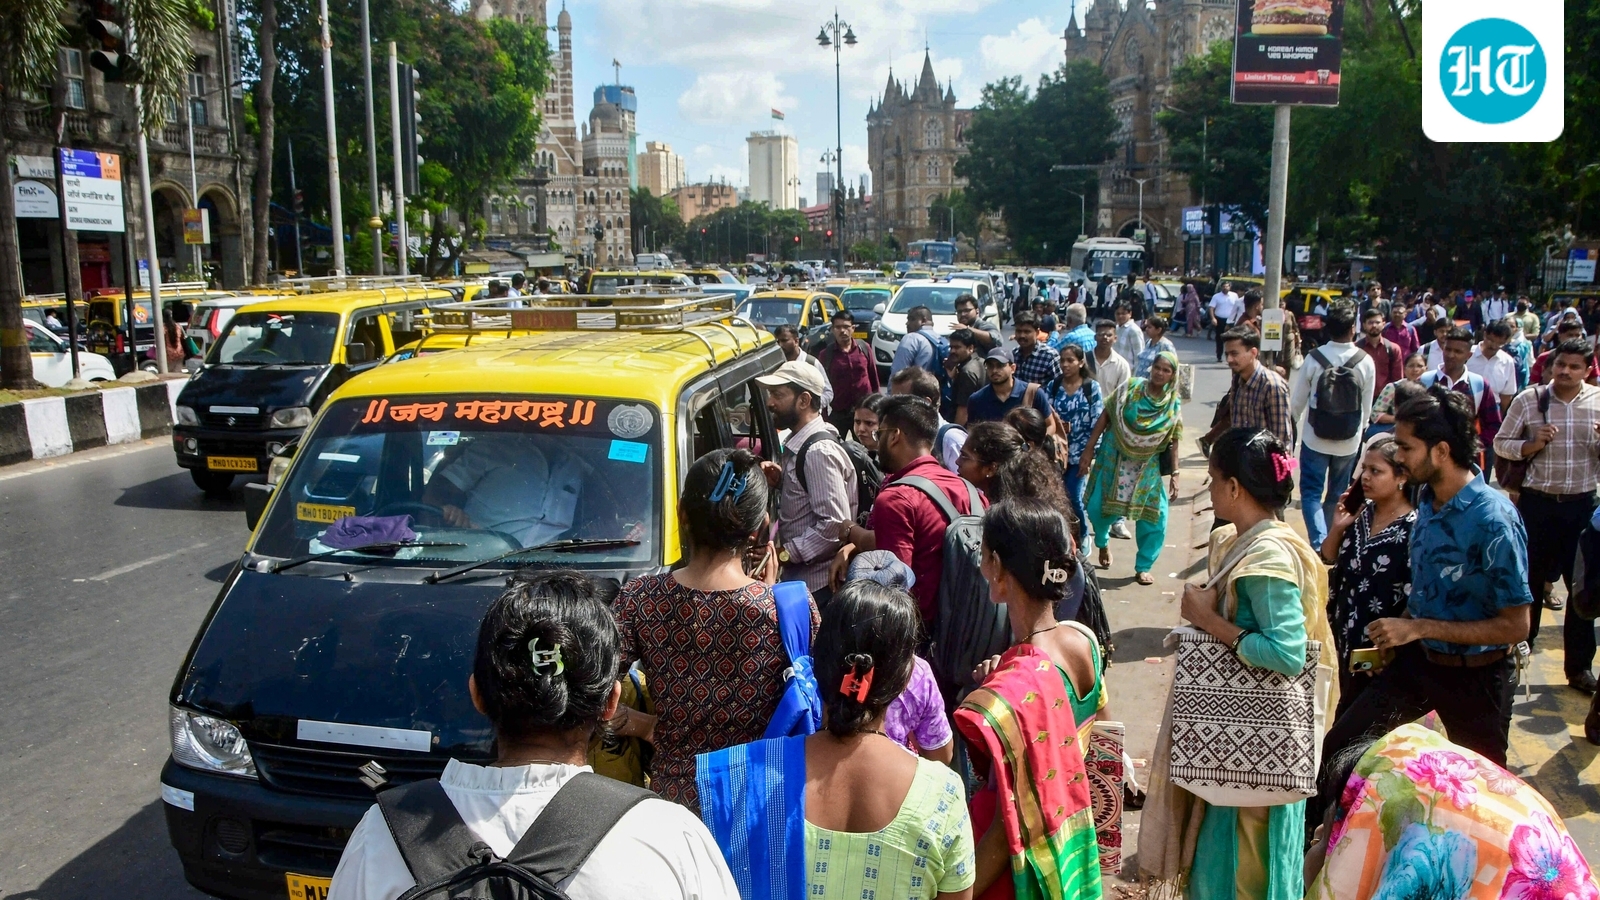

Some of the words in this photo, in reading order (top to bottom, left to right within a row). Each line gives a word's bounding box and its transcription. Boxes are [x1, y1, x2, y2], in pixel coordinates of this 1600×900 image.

[29, 168, 54, 177] MAHE
[18, 186, 37, 195] FinX
[1092, 250, 1142, 258] BALAJI
